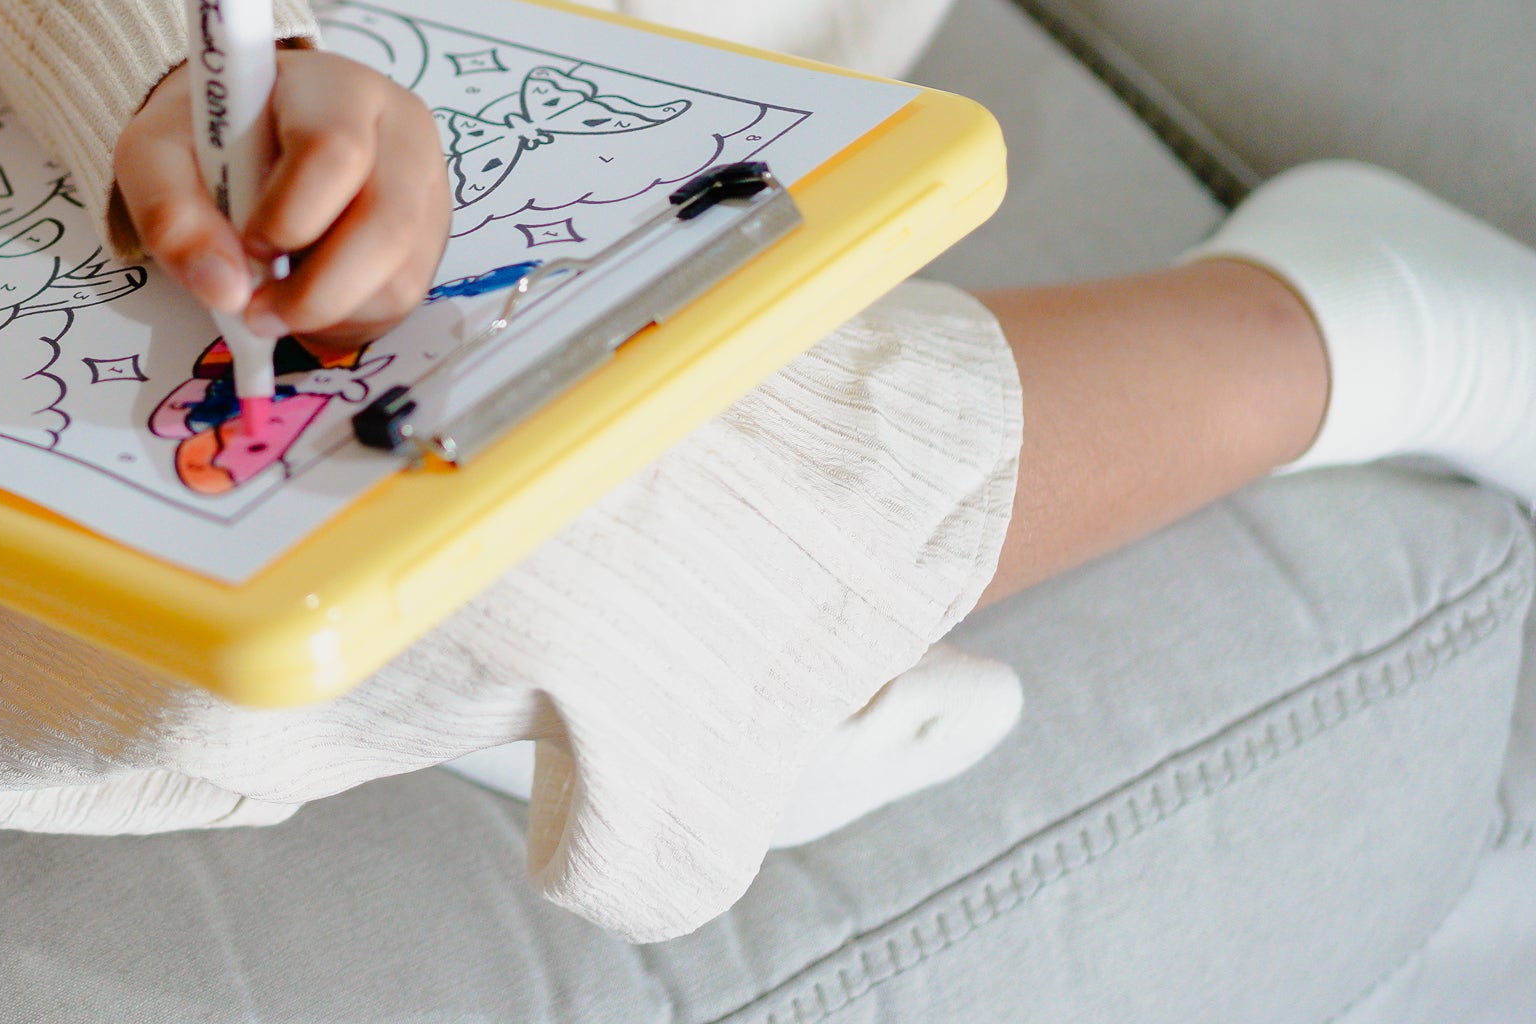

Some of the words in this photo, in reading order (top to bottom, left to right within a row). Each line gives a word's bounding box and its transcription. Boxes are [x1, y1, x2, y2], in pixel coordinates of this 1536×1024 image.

[532, 86, 548, 95] 2
[662, 106, 677, 114] 6
[460, 120, 477, 129] 2
[614, 120, 631, 129] 2
[746, 134, 761, 142] 8
[598, 155, 615, 164] 7
[468, 183, 485, 192] 2
[542, 229, 558, 238] 1
[25, 235, 40, 243] 1
[0, 283, 17, 292] 2
[72, 291, 90, 301] 3
[107, 365, 123, 374] 1
